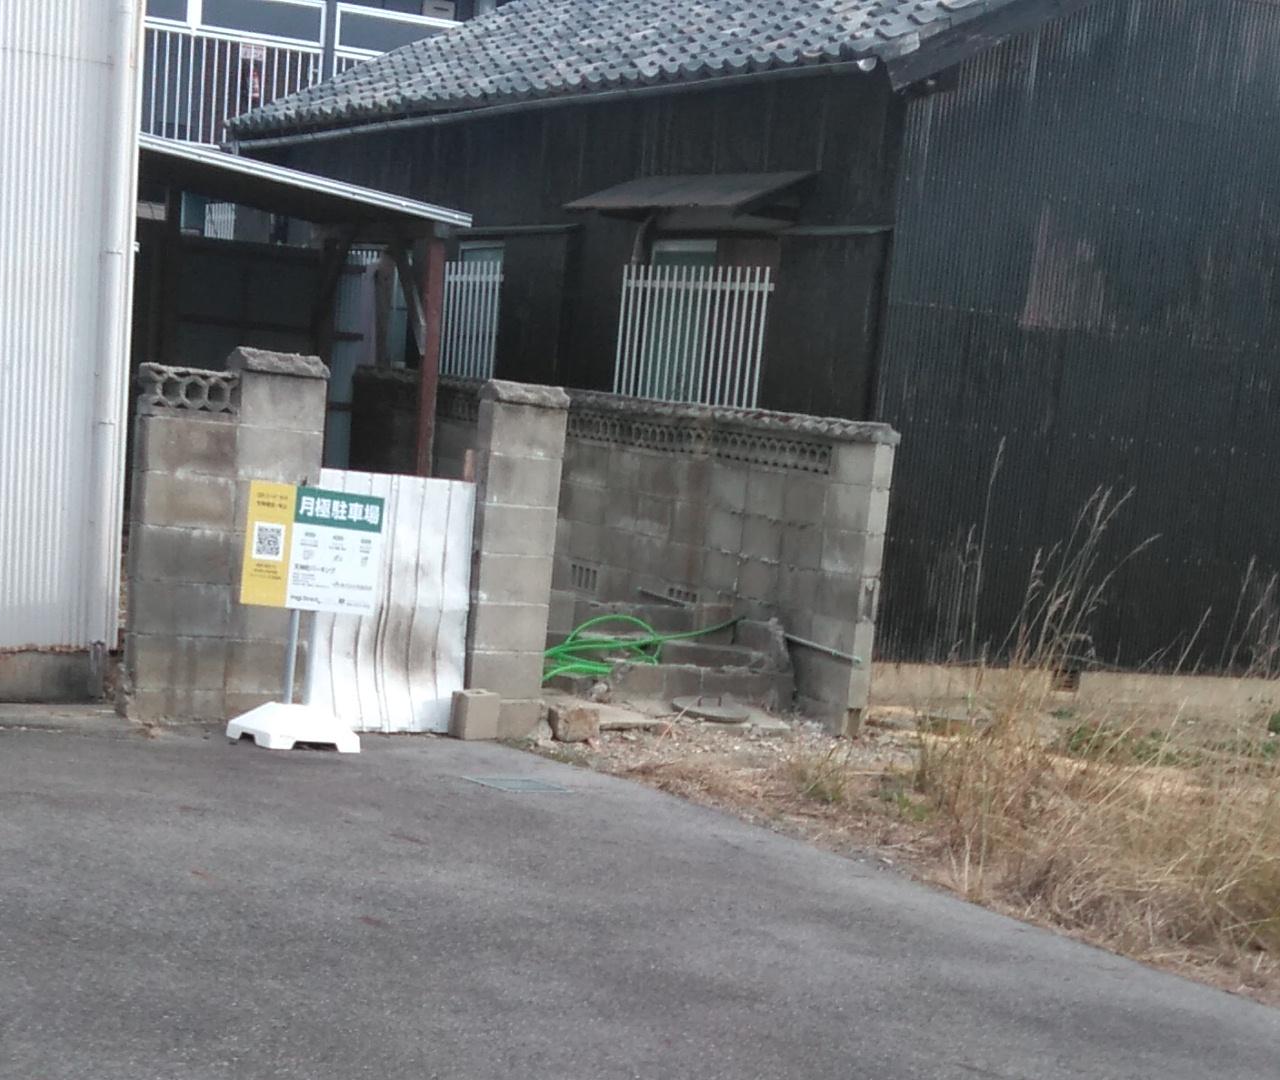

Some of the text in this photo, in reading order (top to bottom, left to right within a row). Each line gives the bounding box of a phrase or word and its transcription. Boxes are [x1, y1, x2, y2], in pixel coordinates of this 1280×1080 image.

[299, 496, 381, 525] 月極駐車場
